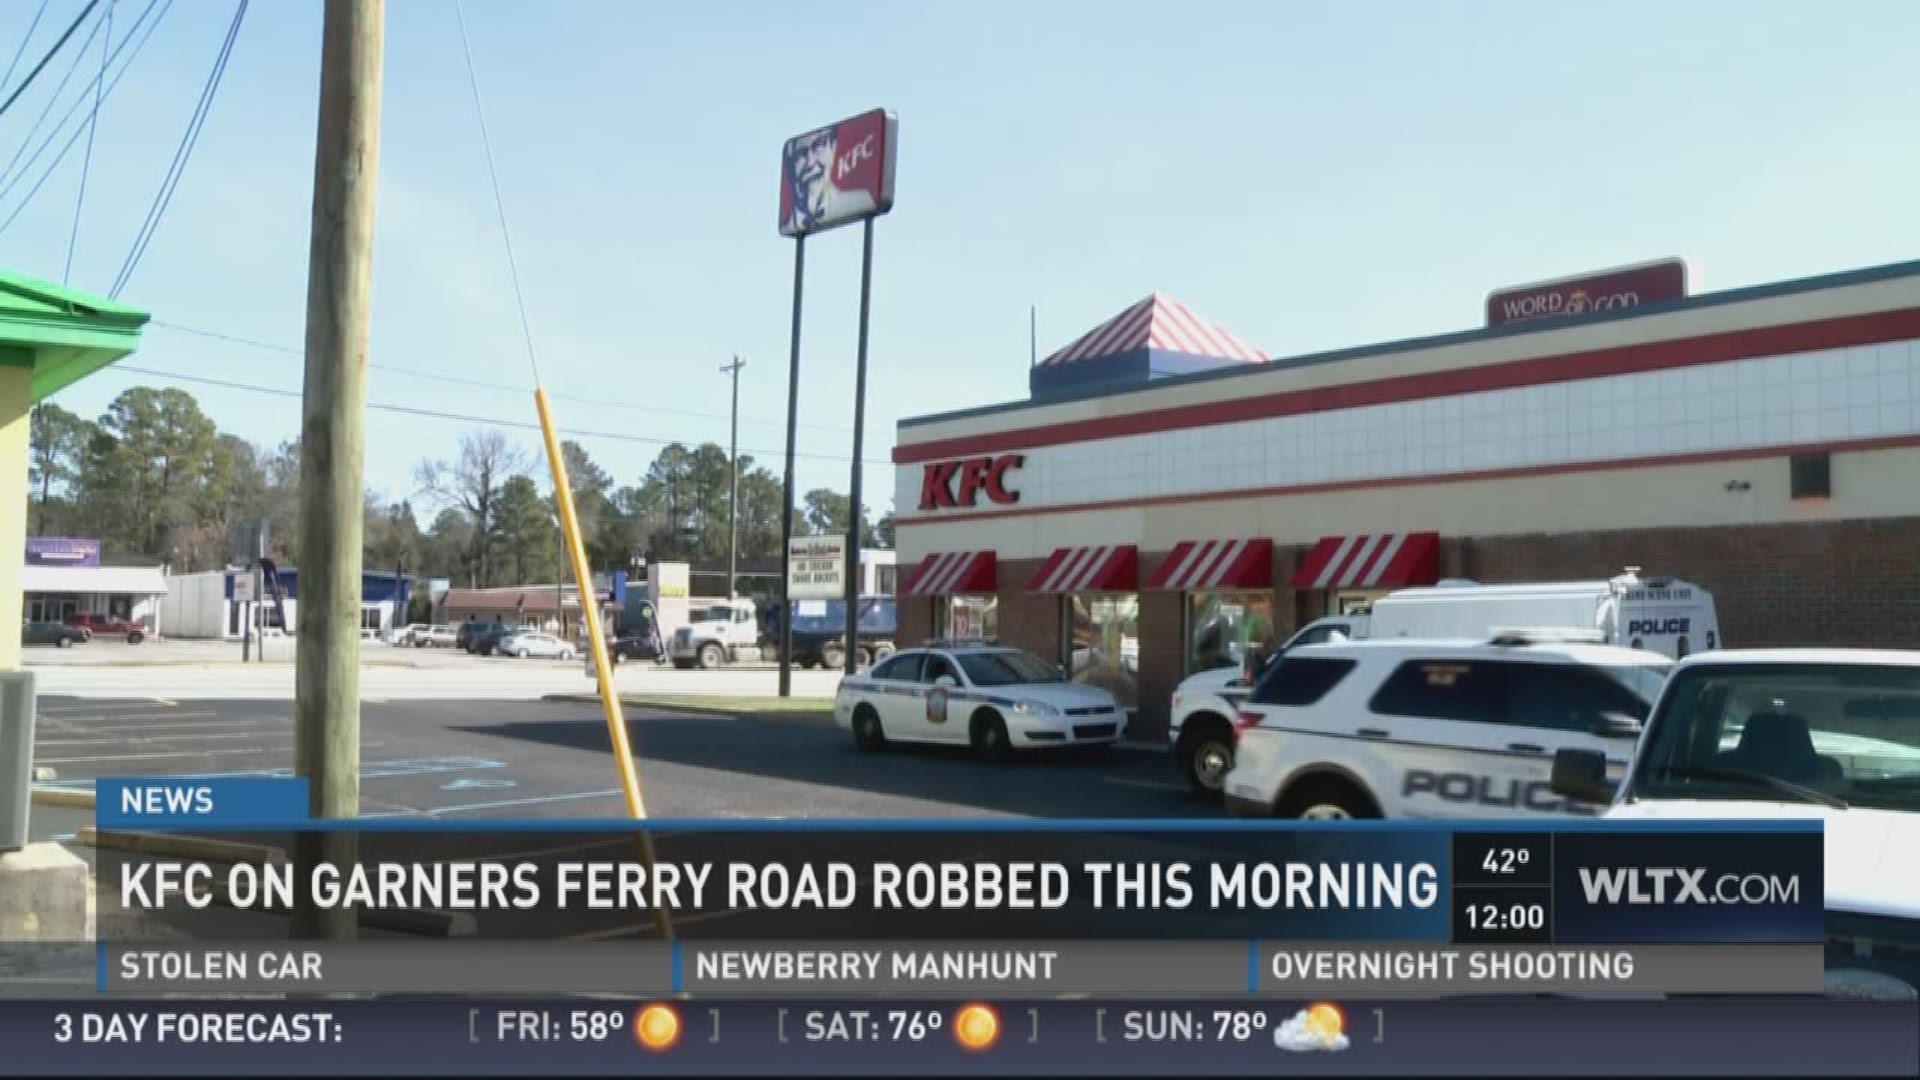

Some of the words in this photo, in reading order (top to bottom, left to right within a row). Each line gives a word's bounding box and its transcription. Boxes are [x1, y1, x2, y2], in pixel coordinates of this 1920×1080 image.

[837, 134, 874, 180] KFC
[1503, 293, 1562, 319] WORD
[918, 454, 1027, 510] KFC
[1629, 618, 1690, 635] POLICE
